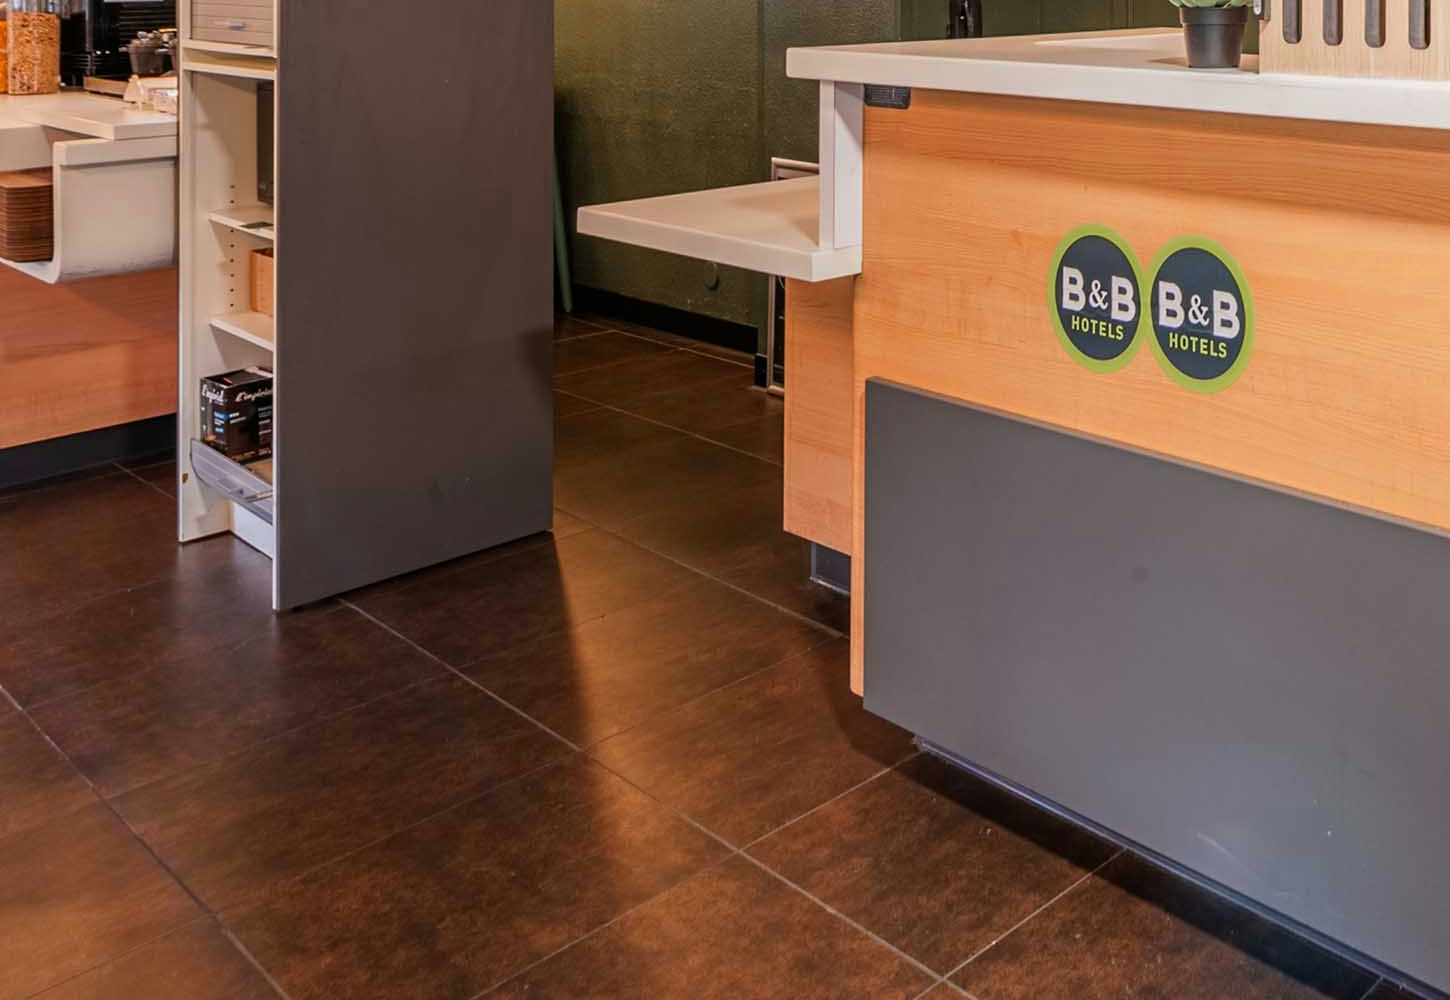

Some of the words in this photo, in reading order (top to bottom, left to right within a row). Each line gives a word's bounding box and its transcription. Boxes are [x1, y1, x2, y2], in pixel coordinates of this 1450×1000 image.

[1062, 265, 1137, 323] B&B
[1158, 279, 1241, 340] B&B
[1071, 314, 1125, 341] HOTELS
[1169, 332, 1228, 359] HOTELS
